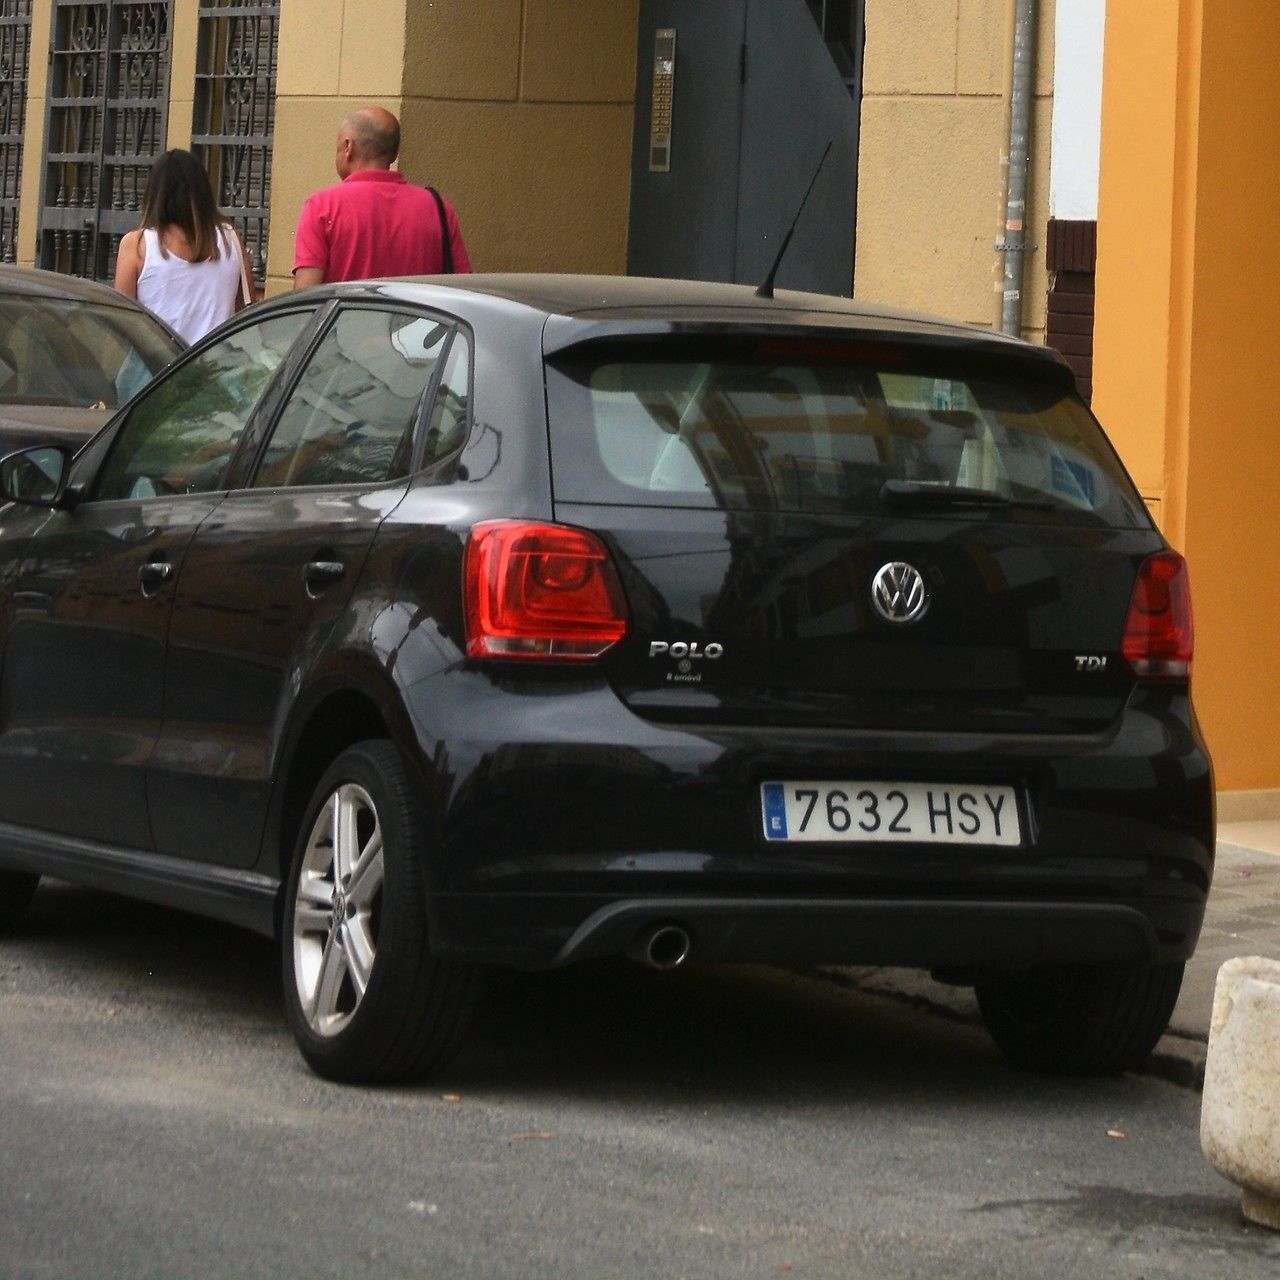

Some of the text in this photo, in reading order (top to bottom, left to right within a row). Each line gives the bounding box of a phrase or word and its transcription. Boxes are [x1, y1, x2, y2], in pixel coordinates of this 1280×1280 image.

[649, 640, 724, 659] POLO
[1075, 655, 1107, 672] TDI
[795, 789, 1005, 837] 7632 HSY
[771, 816, 781, 830] E
